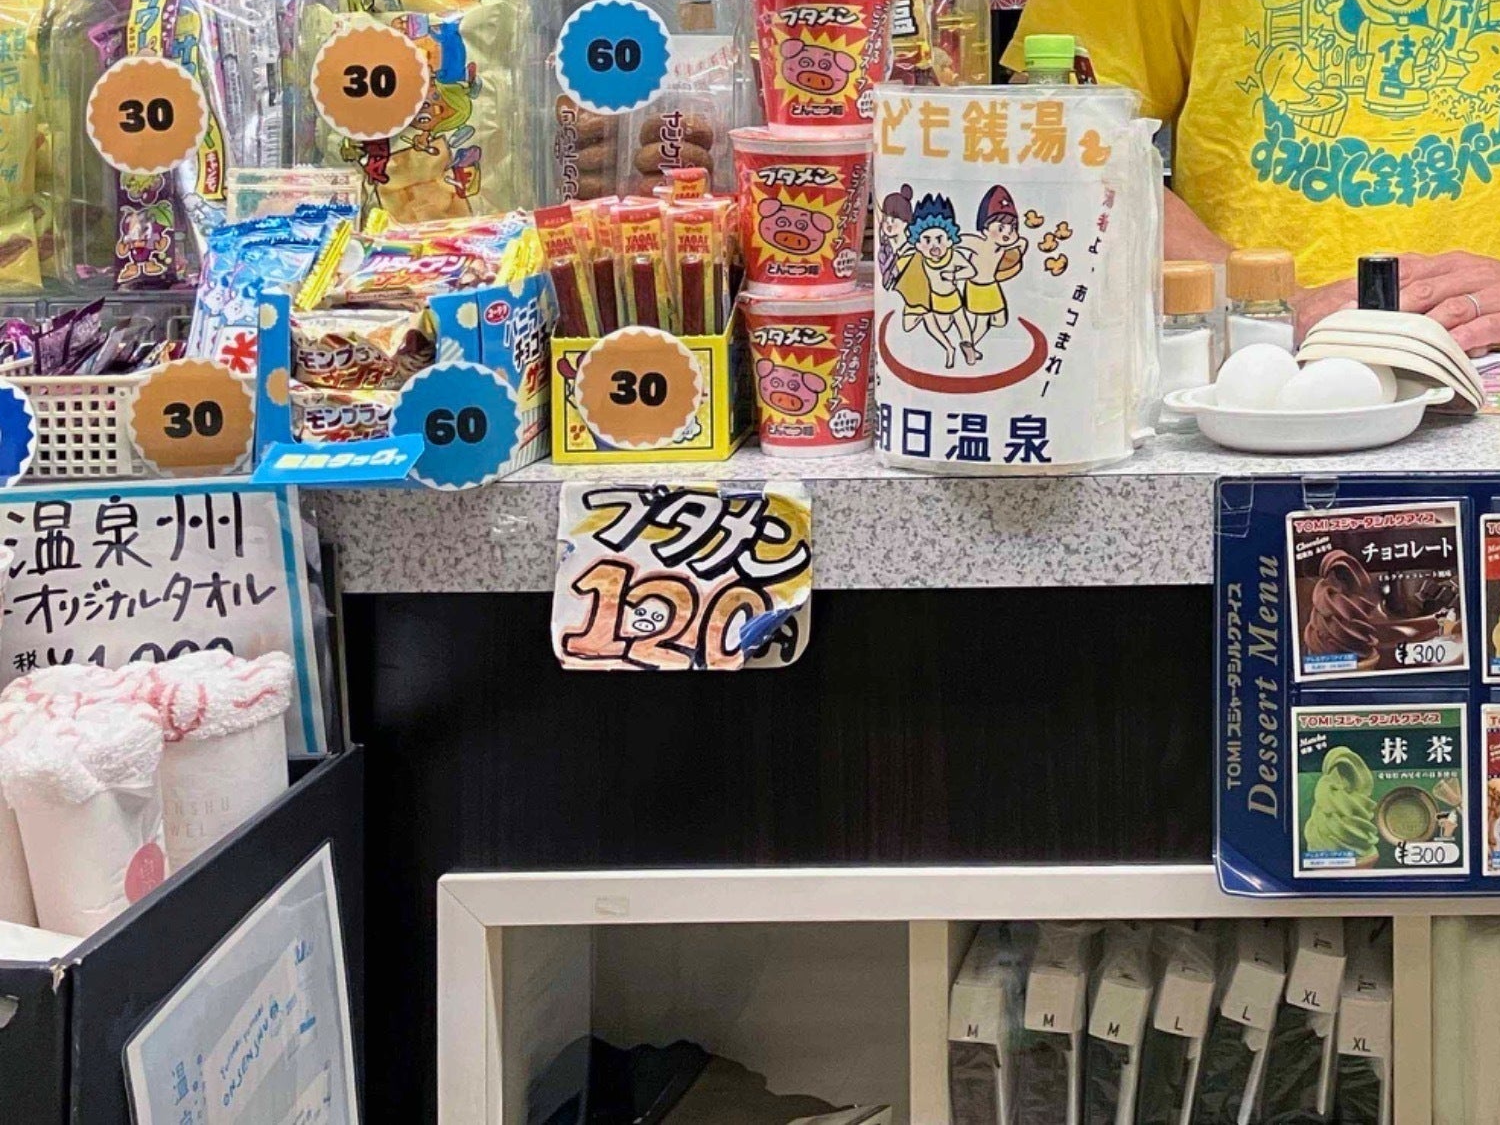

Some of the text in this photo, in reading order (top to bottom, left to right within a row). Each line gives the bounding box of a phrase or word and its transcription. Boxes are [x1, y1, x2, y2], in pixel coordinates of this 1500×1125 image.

[779, 6, 859, 28] ブタメン
[586, 38, 642, 73] 60
[342, 64, 397, 98] 30
[118, 98, 175, 133] 30
[874, 100, 1068, 165] ども銭湯
[758, 168, 837, 186] ブタメン
[752, 327, 828, 347] ブタメン
[1039, 283, 1088, 398] あつまれ!
[609, 369, 668, 408] 30
[163, 400, 224, 440] 30
[424, 405, 489, 446] 60
[582, 483, 812, 586] ブタメン
[1361, 536, 1454, 563] チョコレート
[13, 572, 277, 634] オリジナルタオル
[1247, 554, 1280, 820] Dessert Menu
[1381, 734, 1454, 764] 抹茶
[1226, 743, 1242, 791] TOMI
[1241, 1005, 1252, 1022] L
[1302, 990, 1321, 1007] XL
[966, 1023, 980, 1039] M
[1042, 1013, 1056, 1028] M
[1106, 1022, 1121, 1038] M
[1174, 1015, 1184, 1032] L
[1352, 1036, 1372, 1053] XL
